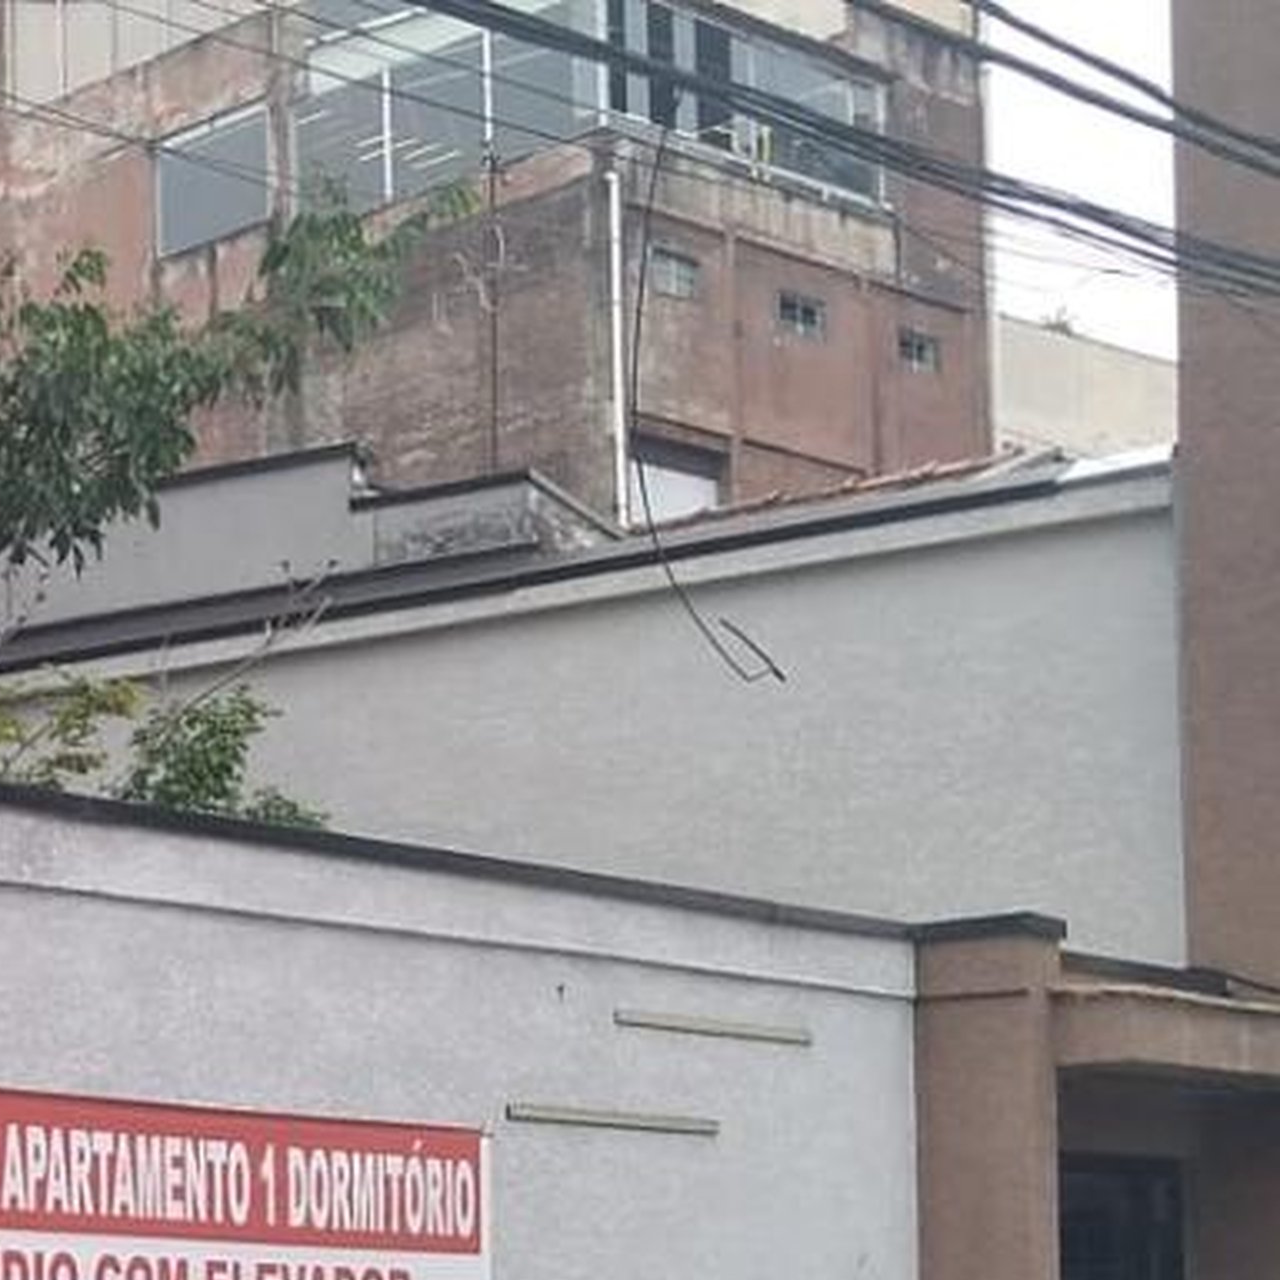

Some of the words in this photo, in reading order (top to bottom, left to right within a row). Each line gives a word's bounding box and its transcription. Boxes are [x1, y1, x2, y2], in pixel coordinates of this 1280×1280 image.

[2, 1124, 251, 1224] APARTAMENTO
[261, 1146, 277, 1224] 1
[287, 1141, 475, 1239] DORMITÓRIO
